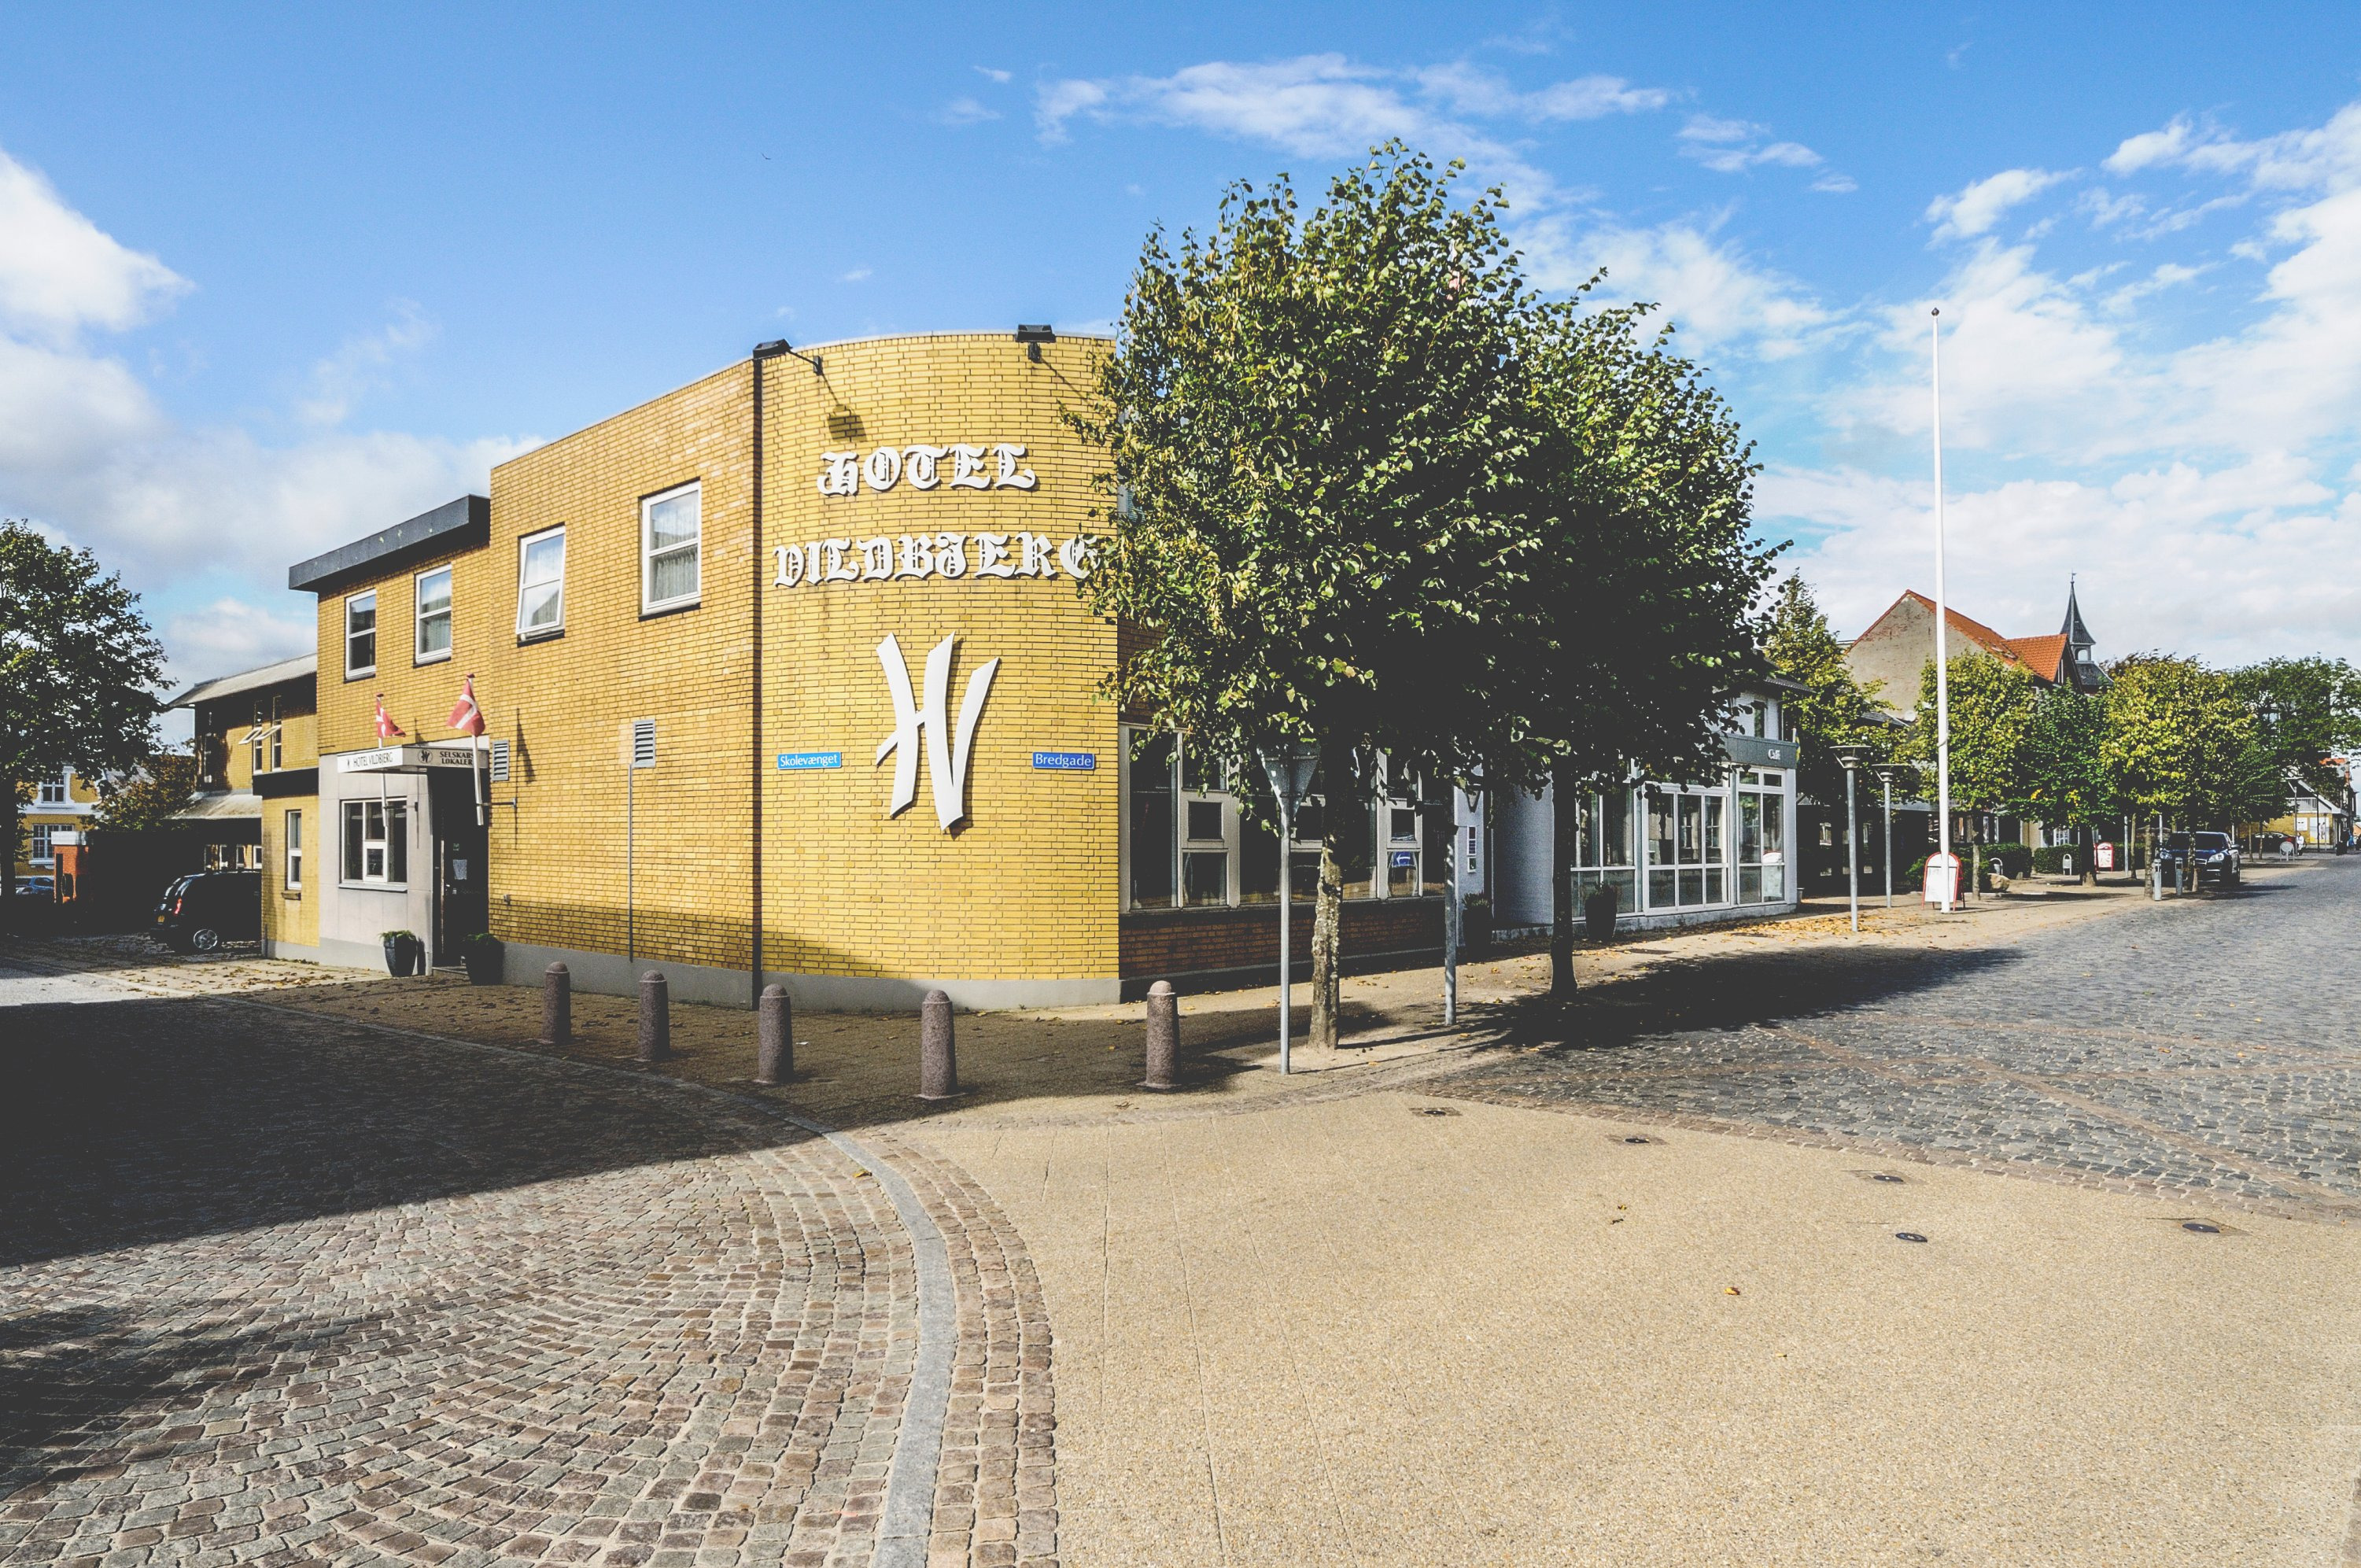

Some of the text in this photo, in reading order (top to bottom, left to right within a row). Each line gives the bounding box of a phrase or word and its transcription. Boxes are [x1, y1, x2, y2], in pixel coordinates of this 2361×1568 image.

[817, 443, 1036, 496] HOTEL
[353, 751, 393, 767] HOTEL VILDBJERG
[780, 754, 837, 766] Skolevænget
[1035, 753, 1091, 768] Bredgade
